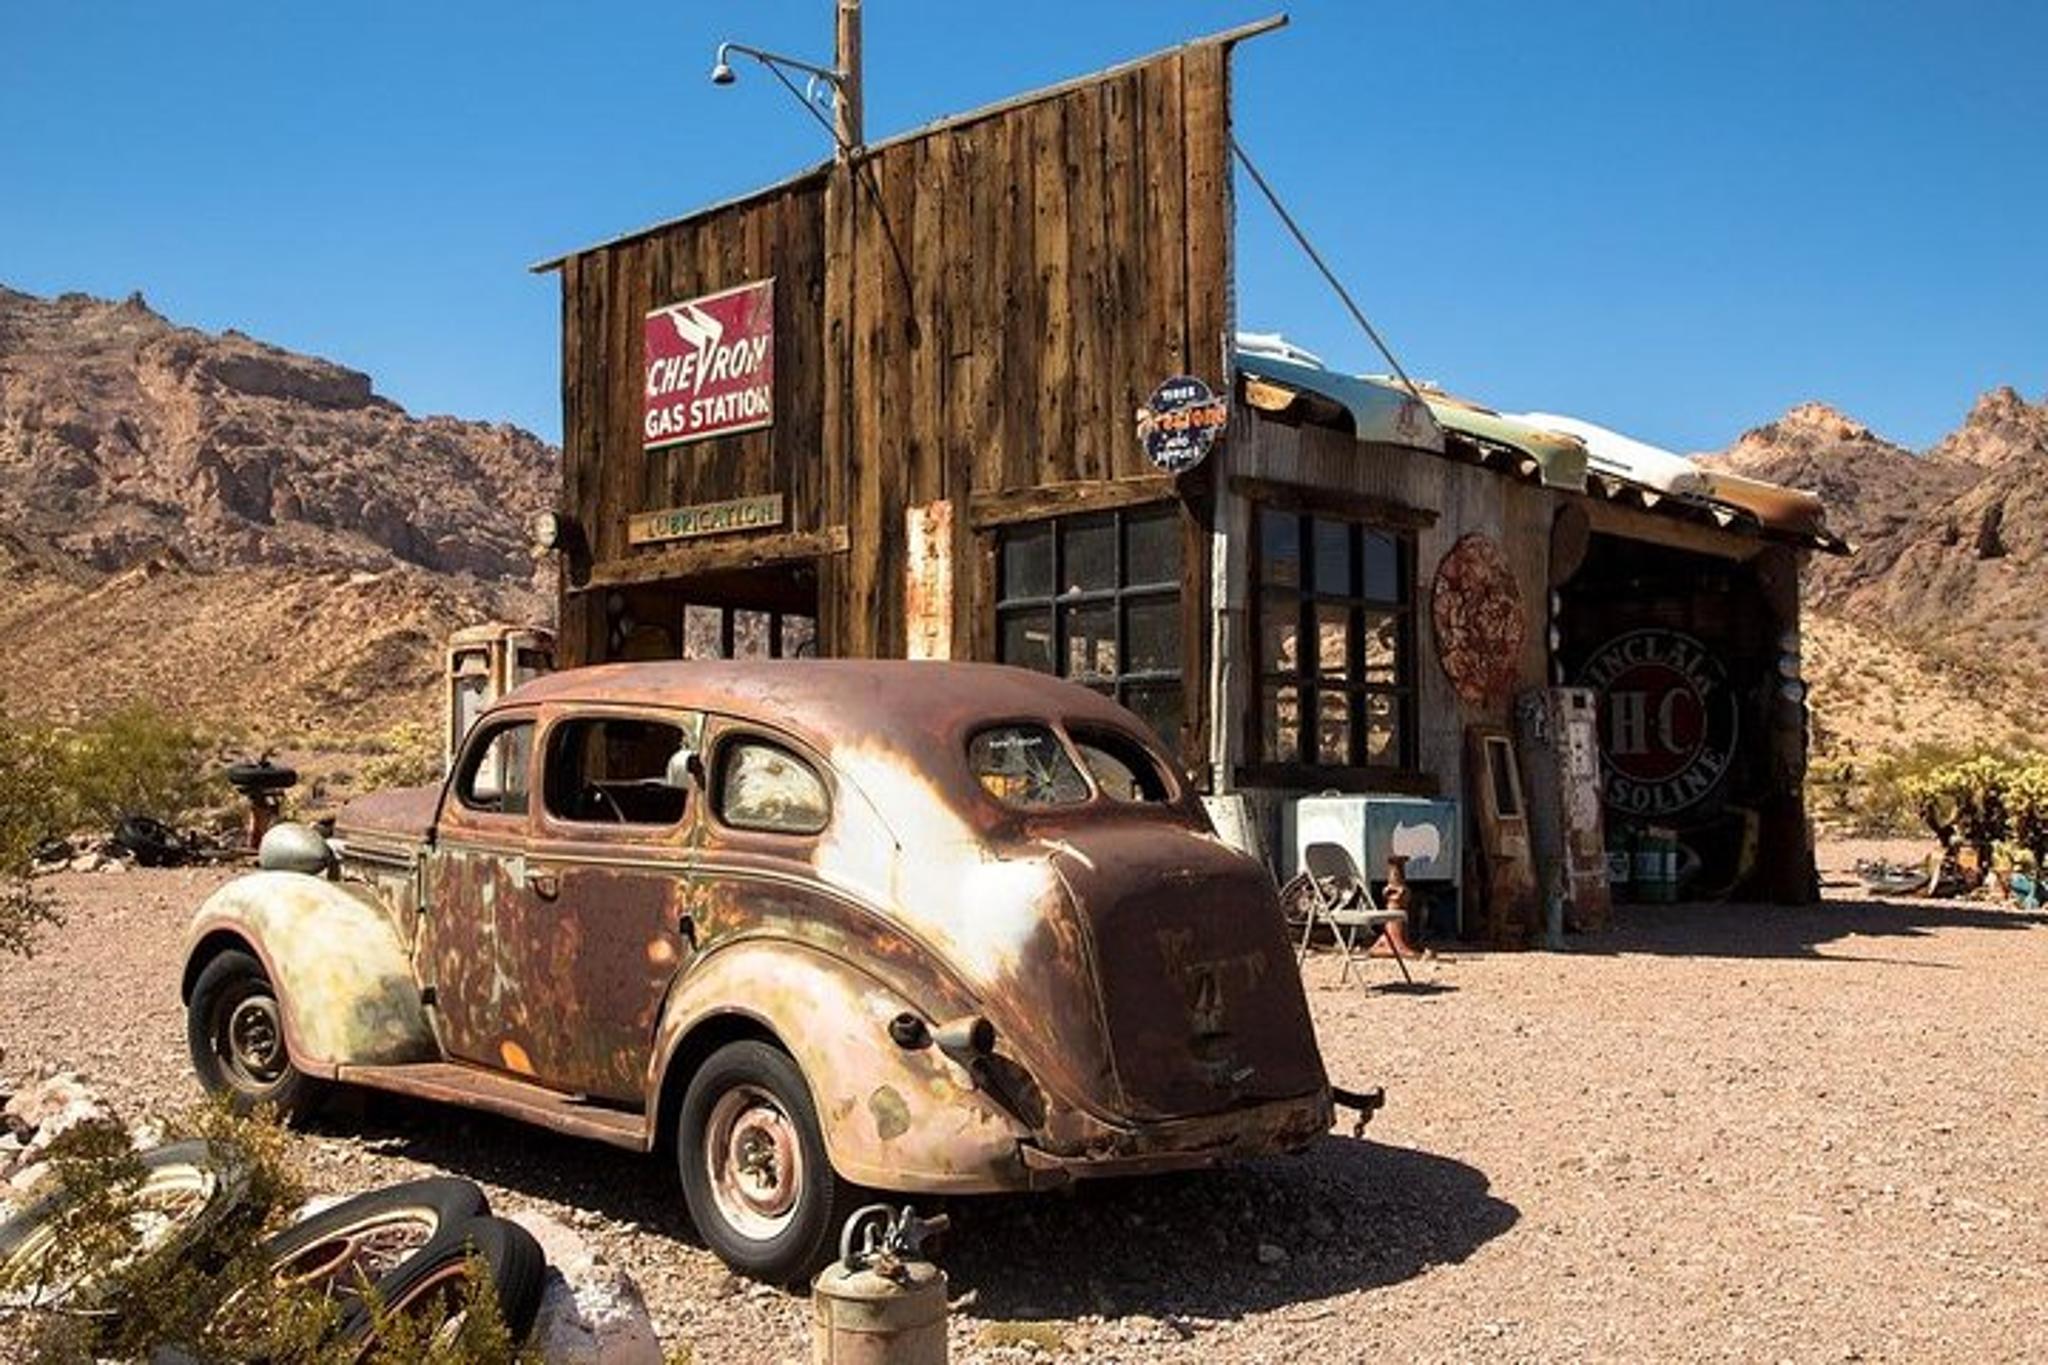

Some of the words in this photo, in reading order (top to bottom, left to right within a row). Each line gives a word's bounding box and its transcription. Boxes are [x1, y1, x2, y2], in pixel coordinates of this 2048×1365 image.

[645, 333, 770, 396] CHEVRON
[645, 403, 685, 438] GAS
[689, 385, 772, 430] STATION
[648, 501, 775, 537] LUBRICATION
